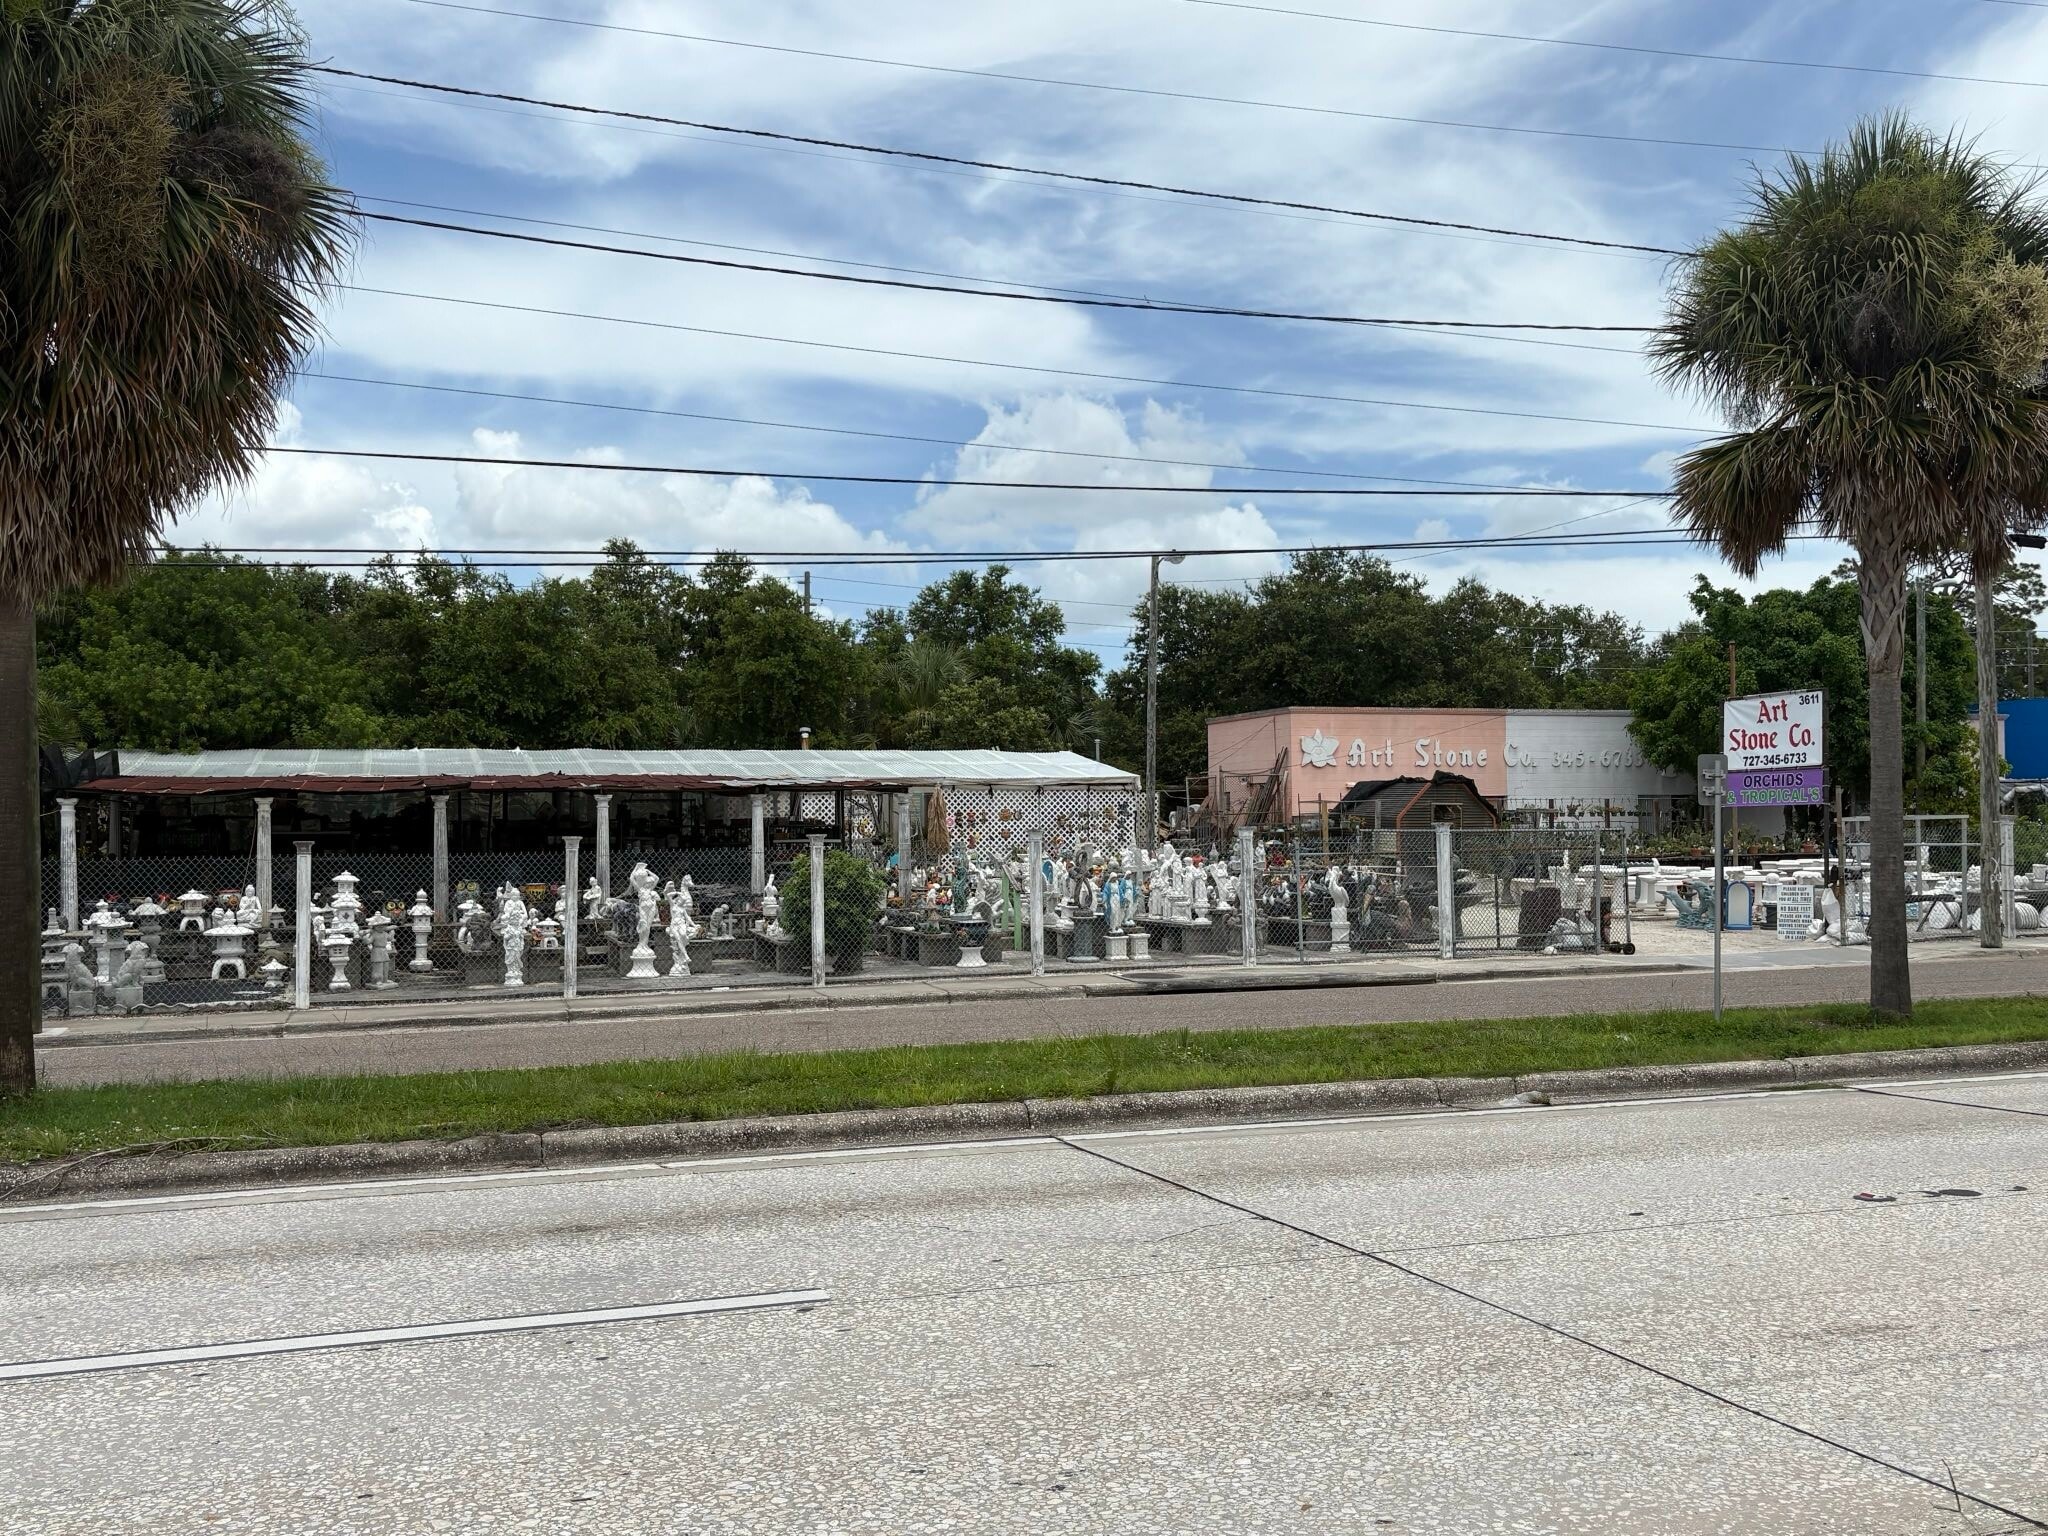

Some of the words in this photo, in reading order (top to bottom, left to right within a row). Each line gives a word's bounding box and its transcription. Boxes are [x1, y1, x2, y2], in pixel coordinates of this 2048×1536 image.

[1798, 694, 1819, 706] 3611
[1757, 699, 1788, 724] Art
[1729, 728, 1778, 752] Stone
[1789, 723, 1816, 748] Co.
[1346, 737, 1394, 768] Art
[1415, 738, 1488, 768] Stone
[1504, 742, 1537, 768] Co.
[1743, 752, 1807, 766] 727-345-6733
[1743, 773, 1804, 788] ORCHIDS
[1727, 791, 1736, 804] &
[1741, 788, 1820, 804] TROPICAL'S
